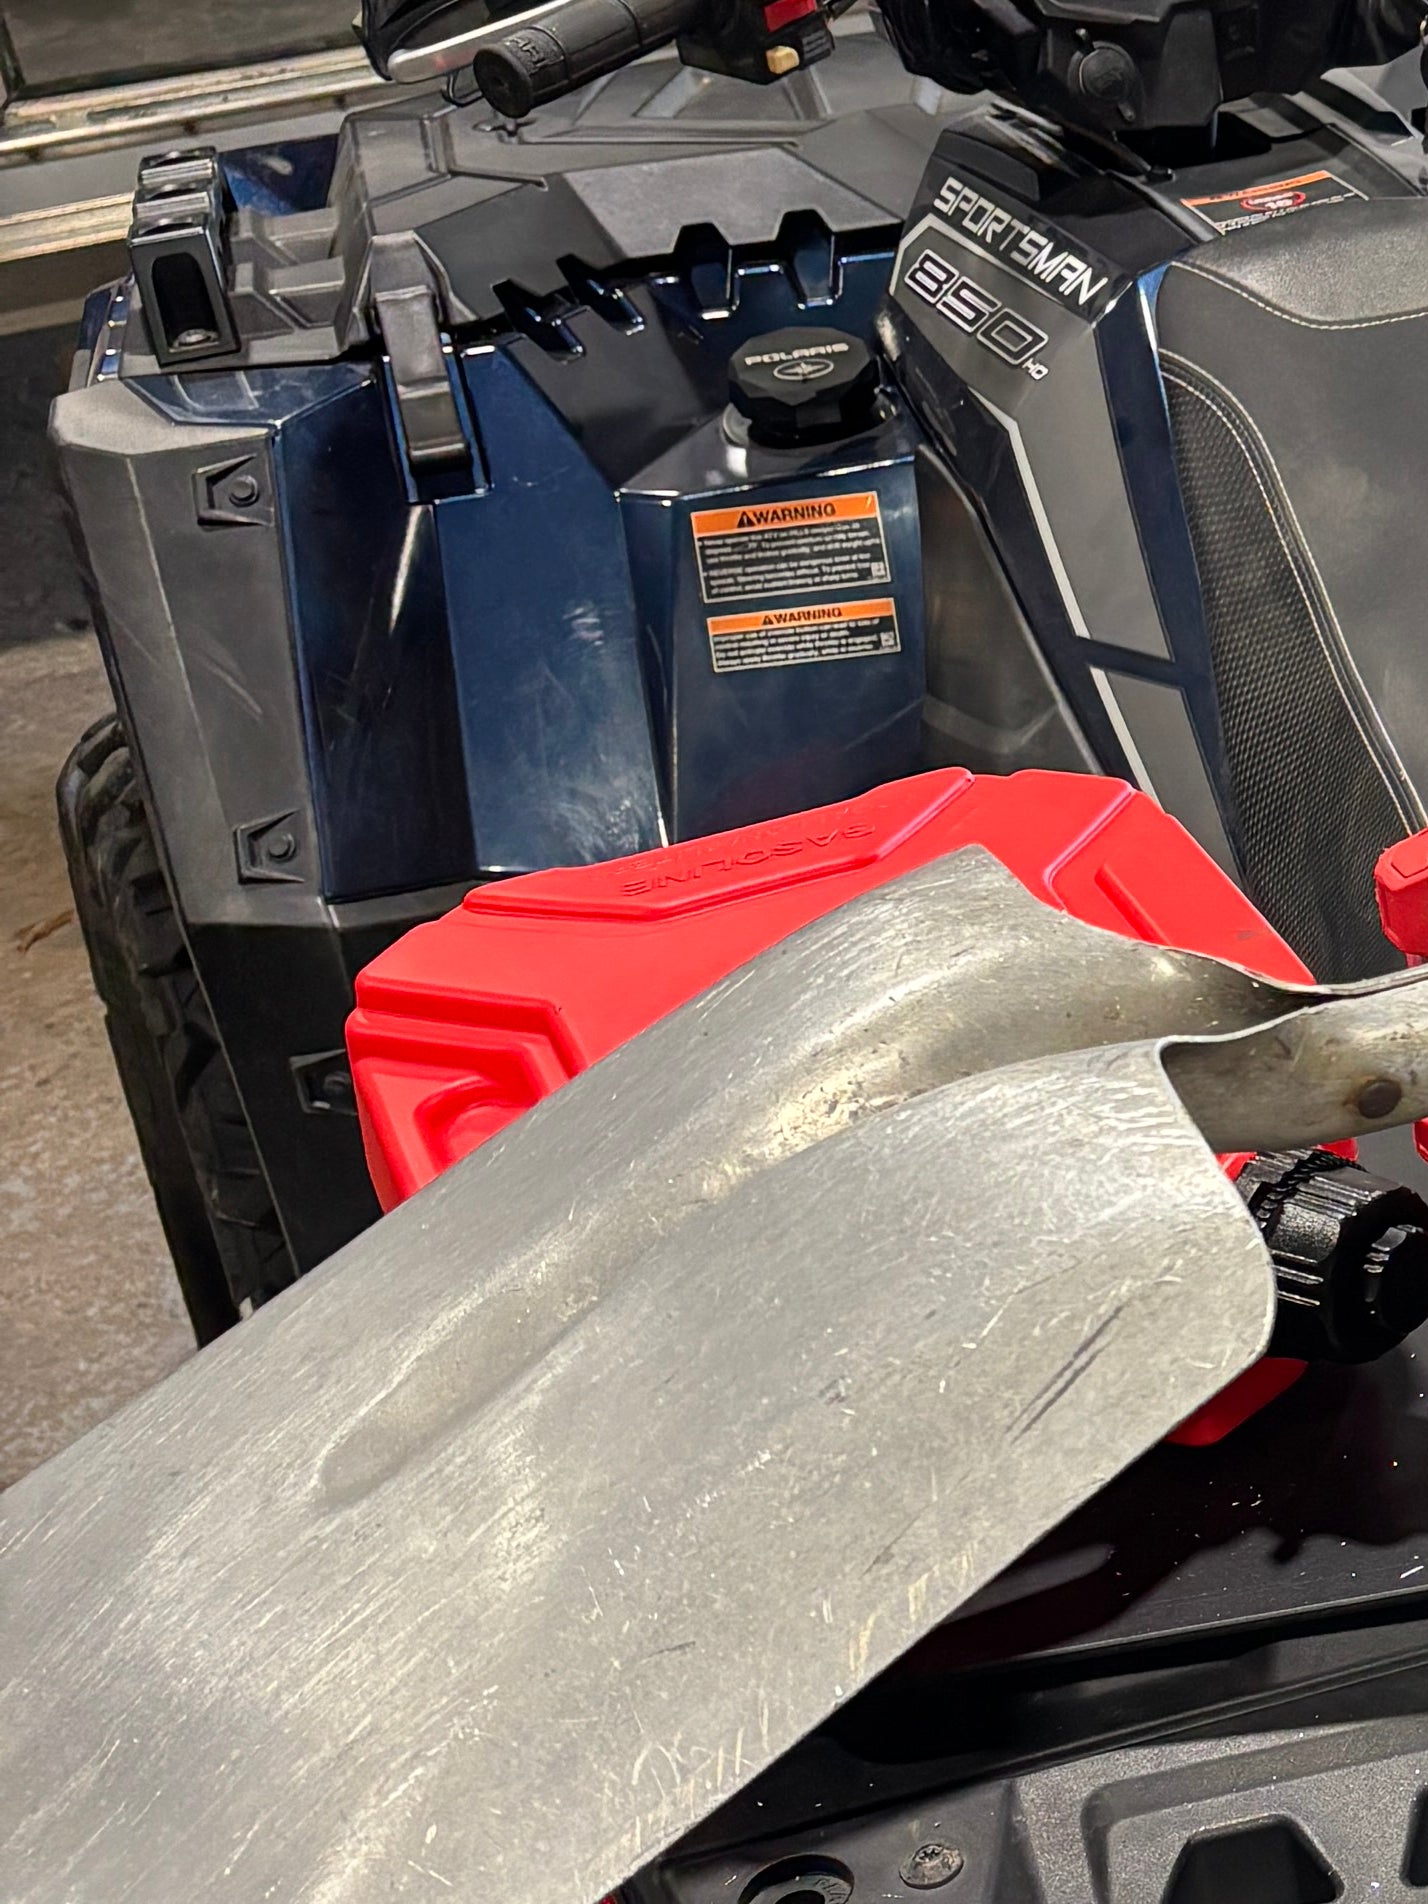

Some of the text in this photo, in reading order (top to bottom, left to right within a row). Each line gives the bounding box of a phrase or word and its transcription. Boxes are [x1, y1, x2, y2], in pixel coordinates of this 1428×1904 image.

[933, 176, 1109, 306] SPORTSMAN
[904, 248, 1049, 365] 850
[744, 342, 849, 366] POLARIS
[752, 502, 837, 525] WARNING
[772, 606, 843, 624] WARNING
[620, 823, 876, 897] GASOLINE
